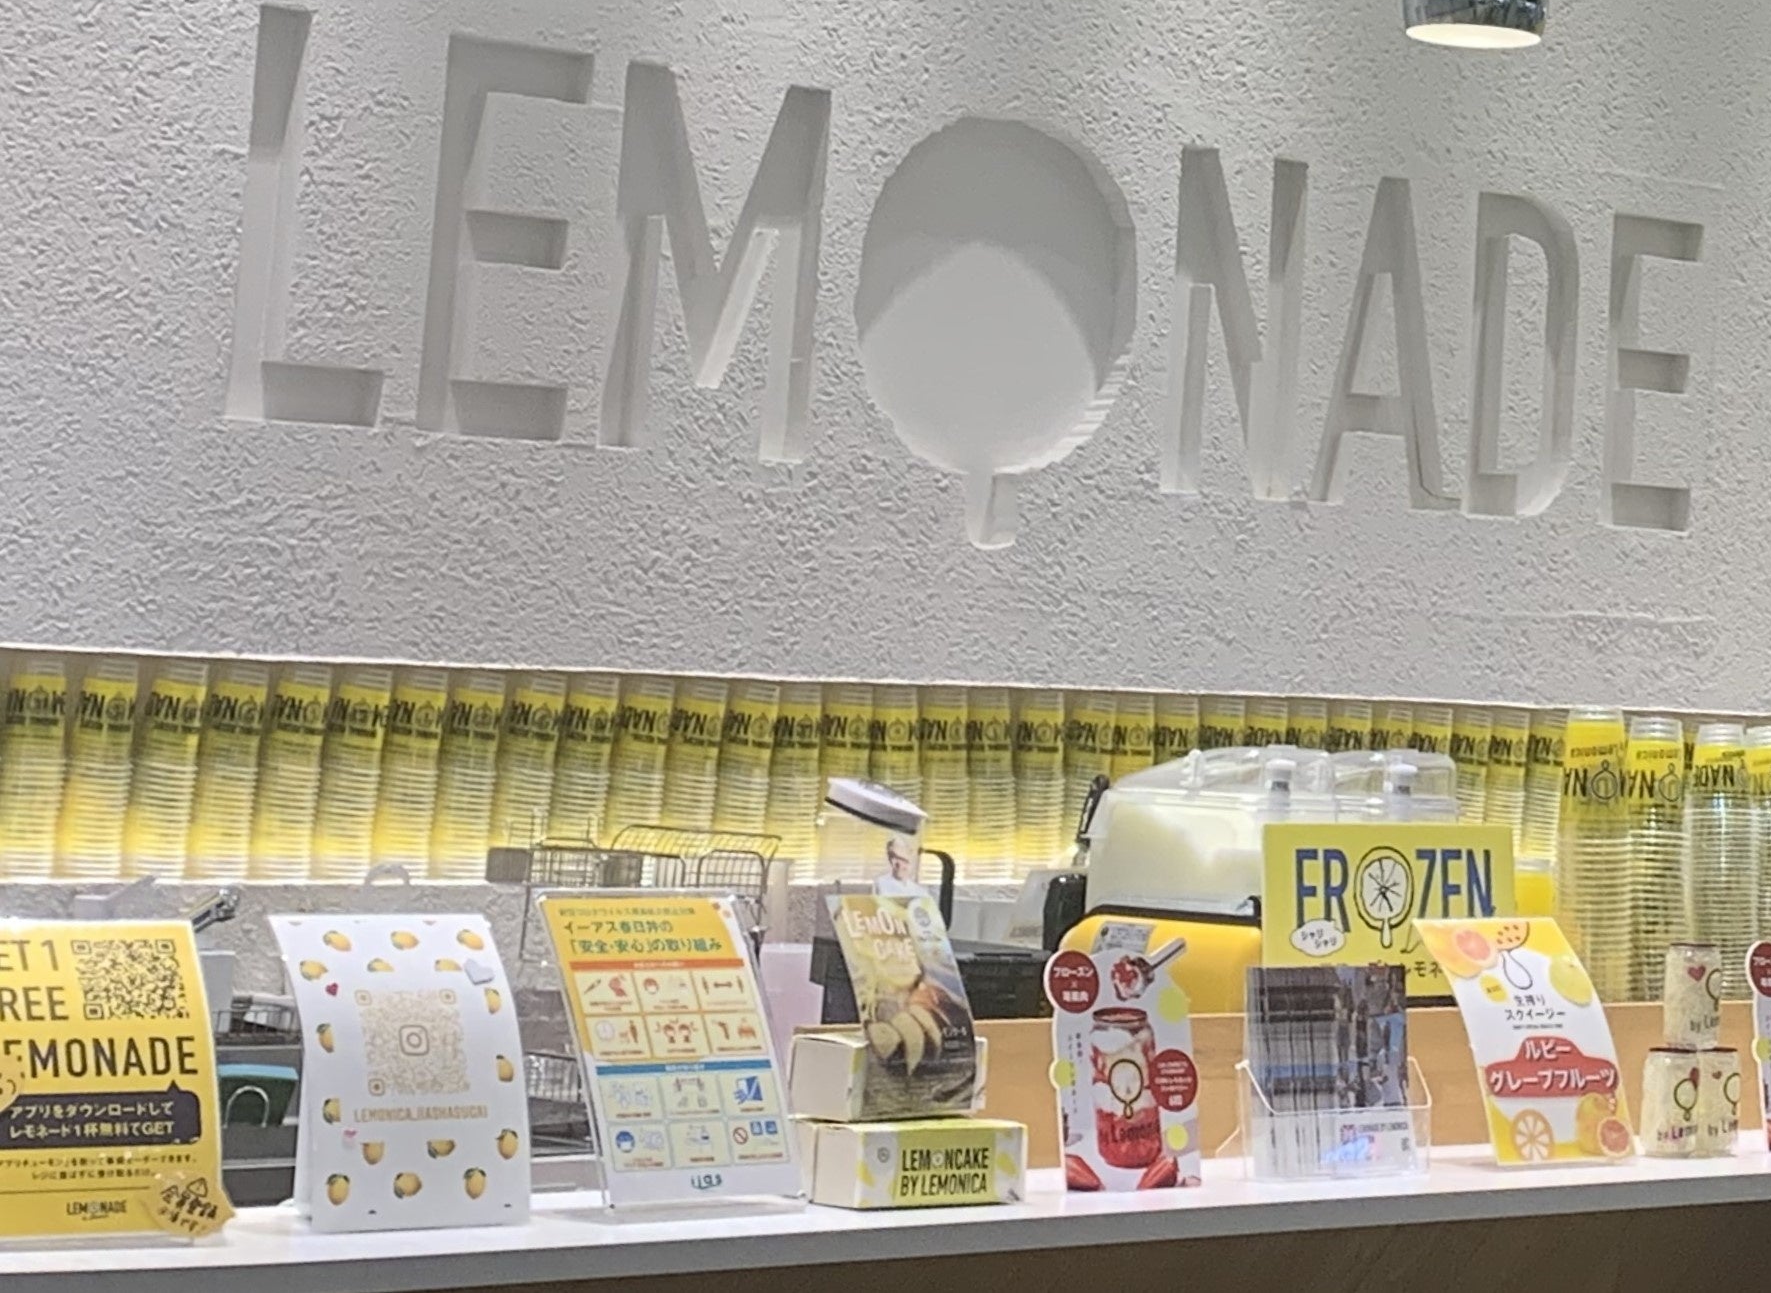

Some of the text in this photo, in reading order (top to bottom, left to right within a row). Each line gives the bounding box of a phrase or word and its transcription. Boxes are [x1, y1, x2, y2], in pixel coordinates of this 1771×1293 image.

[563, 920, 674, 935] イーアス春日井の
[41, 939, 59, 971] 1
[1523, 1039, 1573, 1061] ルビー
[1488, 1067, 1616, 1093] グレープフルーツ
[9, 1100, 175, 1120] アプリをダウンロードして
[900, 1172, 988, 1197] BY LEMONICA
